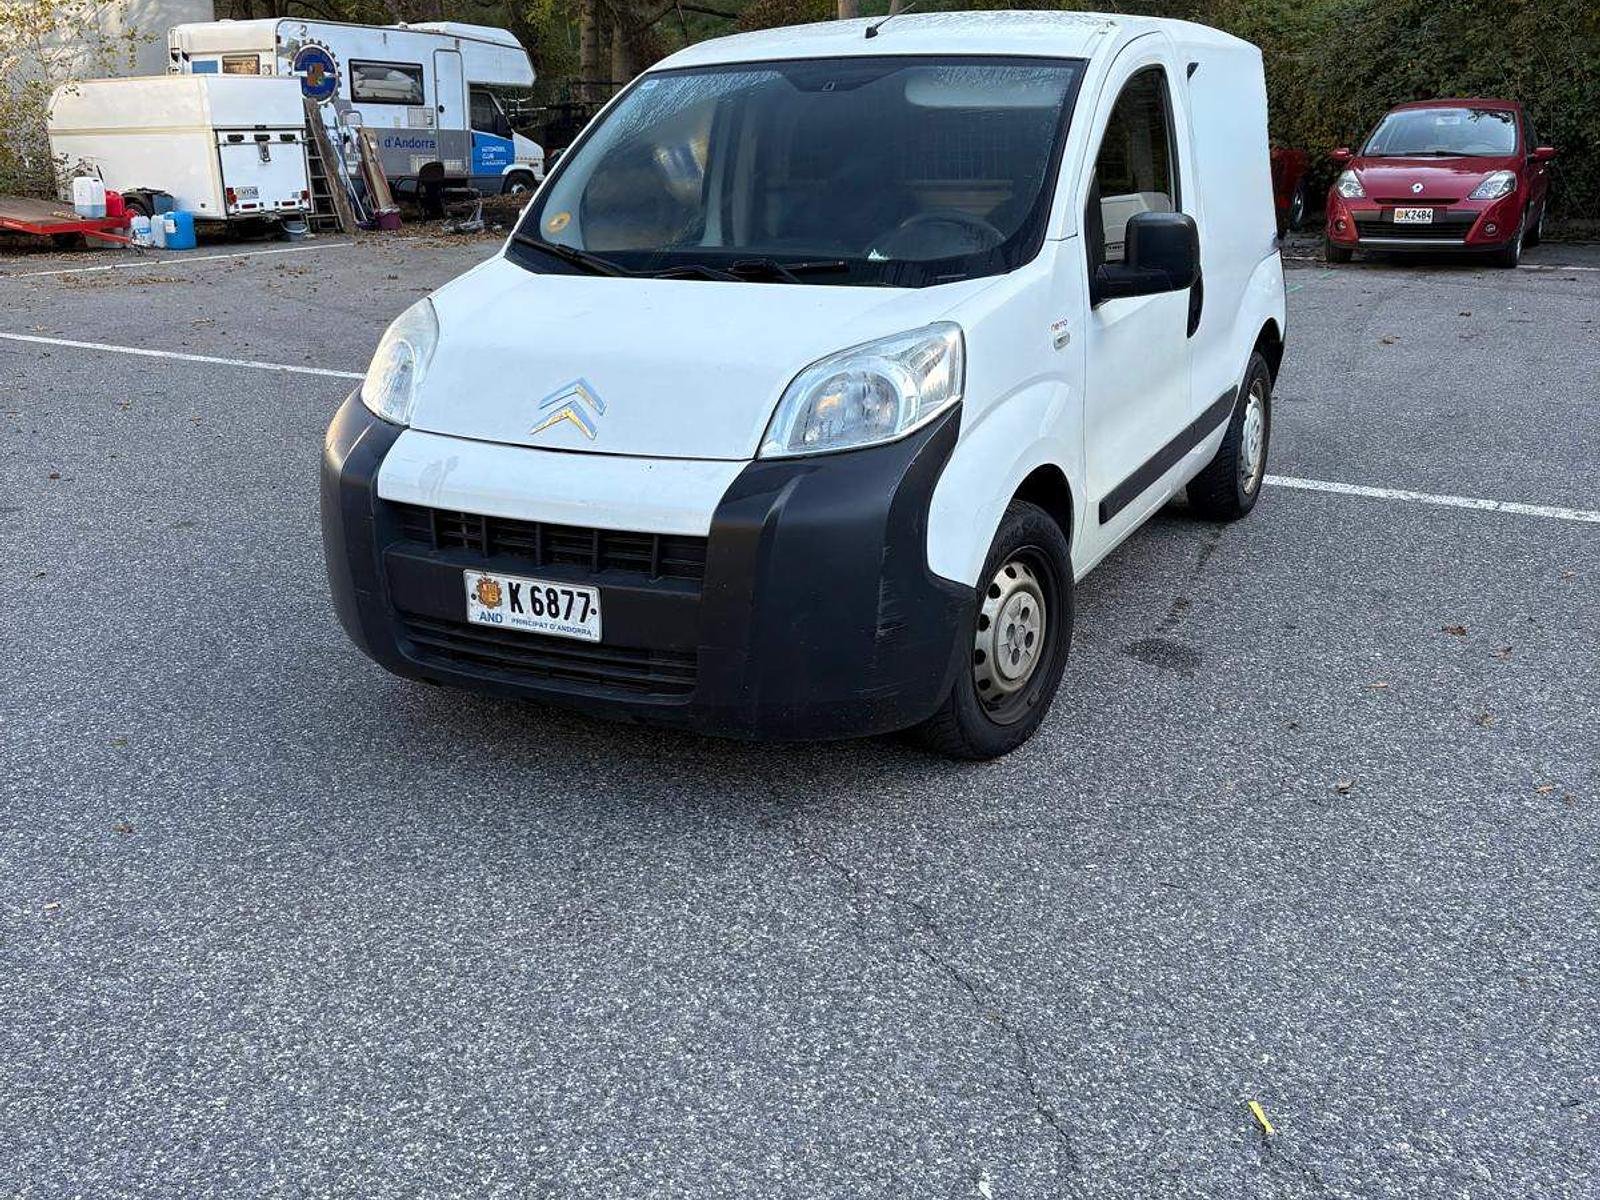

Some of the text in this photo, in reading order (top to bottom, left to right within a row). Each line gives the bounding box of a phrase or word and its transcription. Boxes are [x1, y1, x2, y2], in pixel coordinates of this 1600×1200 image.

[384, 136, 436, 149] d'Andorra
[508, 582, 590, 623] K 6877
[479, 611, 503, 624] AND
[511, 618, 592, 637] PRINCIPAT D'ANDORRA
